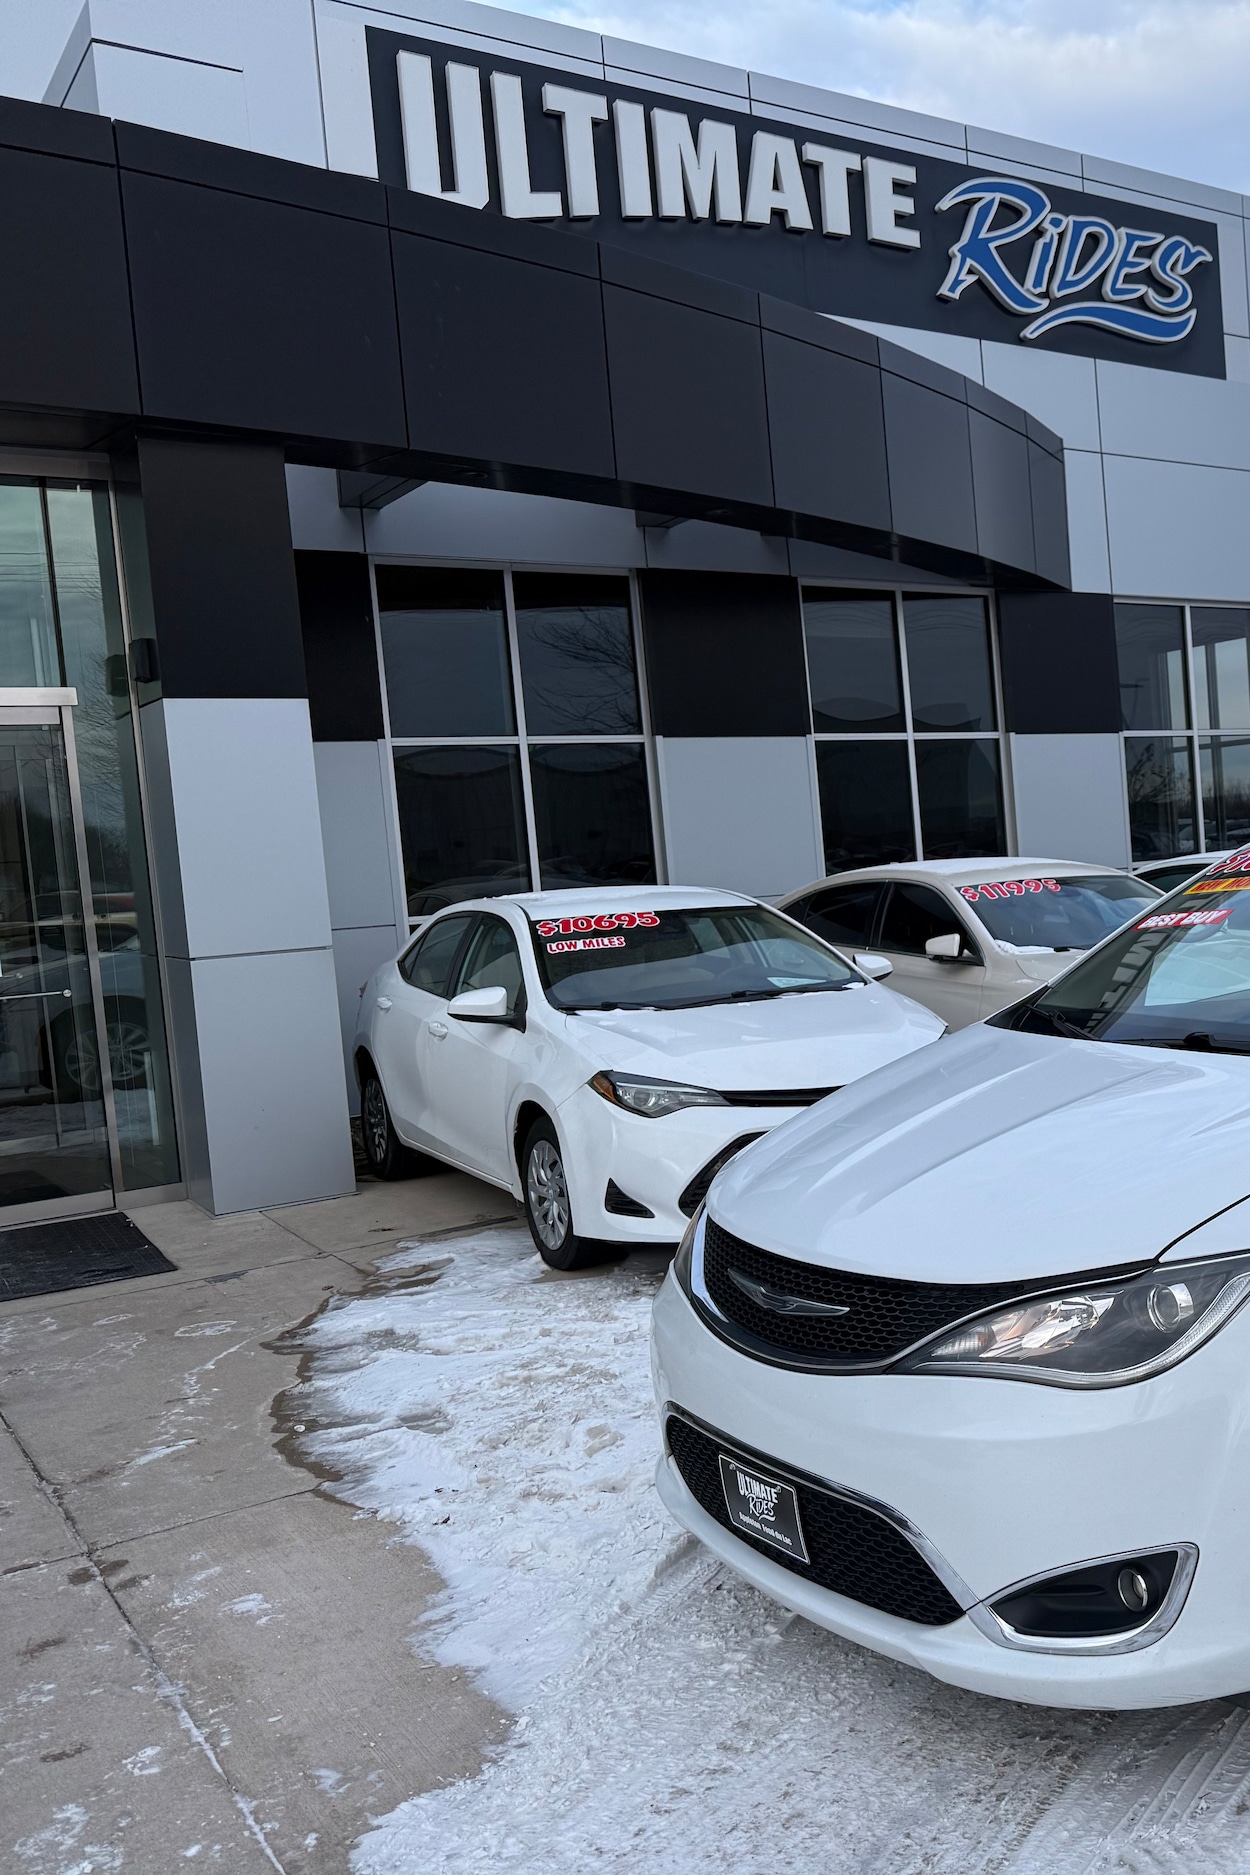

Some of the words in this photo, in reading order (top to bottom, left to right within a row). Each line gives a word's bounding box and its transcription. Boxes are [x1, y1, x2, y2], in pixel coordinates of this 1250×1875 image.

[396, 49, 921, 251] ULTIMATE
[960, 879, 1061, 902] $11995
[536, 911, 660, 936] $10695
[1137, 912, 1188, 929] BEST
[1183, 910, 1228, 925] BUY
[547, 940, 578, 954] LOW
[582, 936, 626, 949] MILES
[736, 1470, 779, 1504] ULTIMATE
